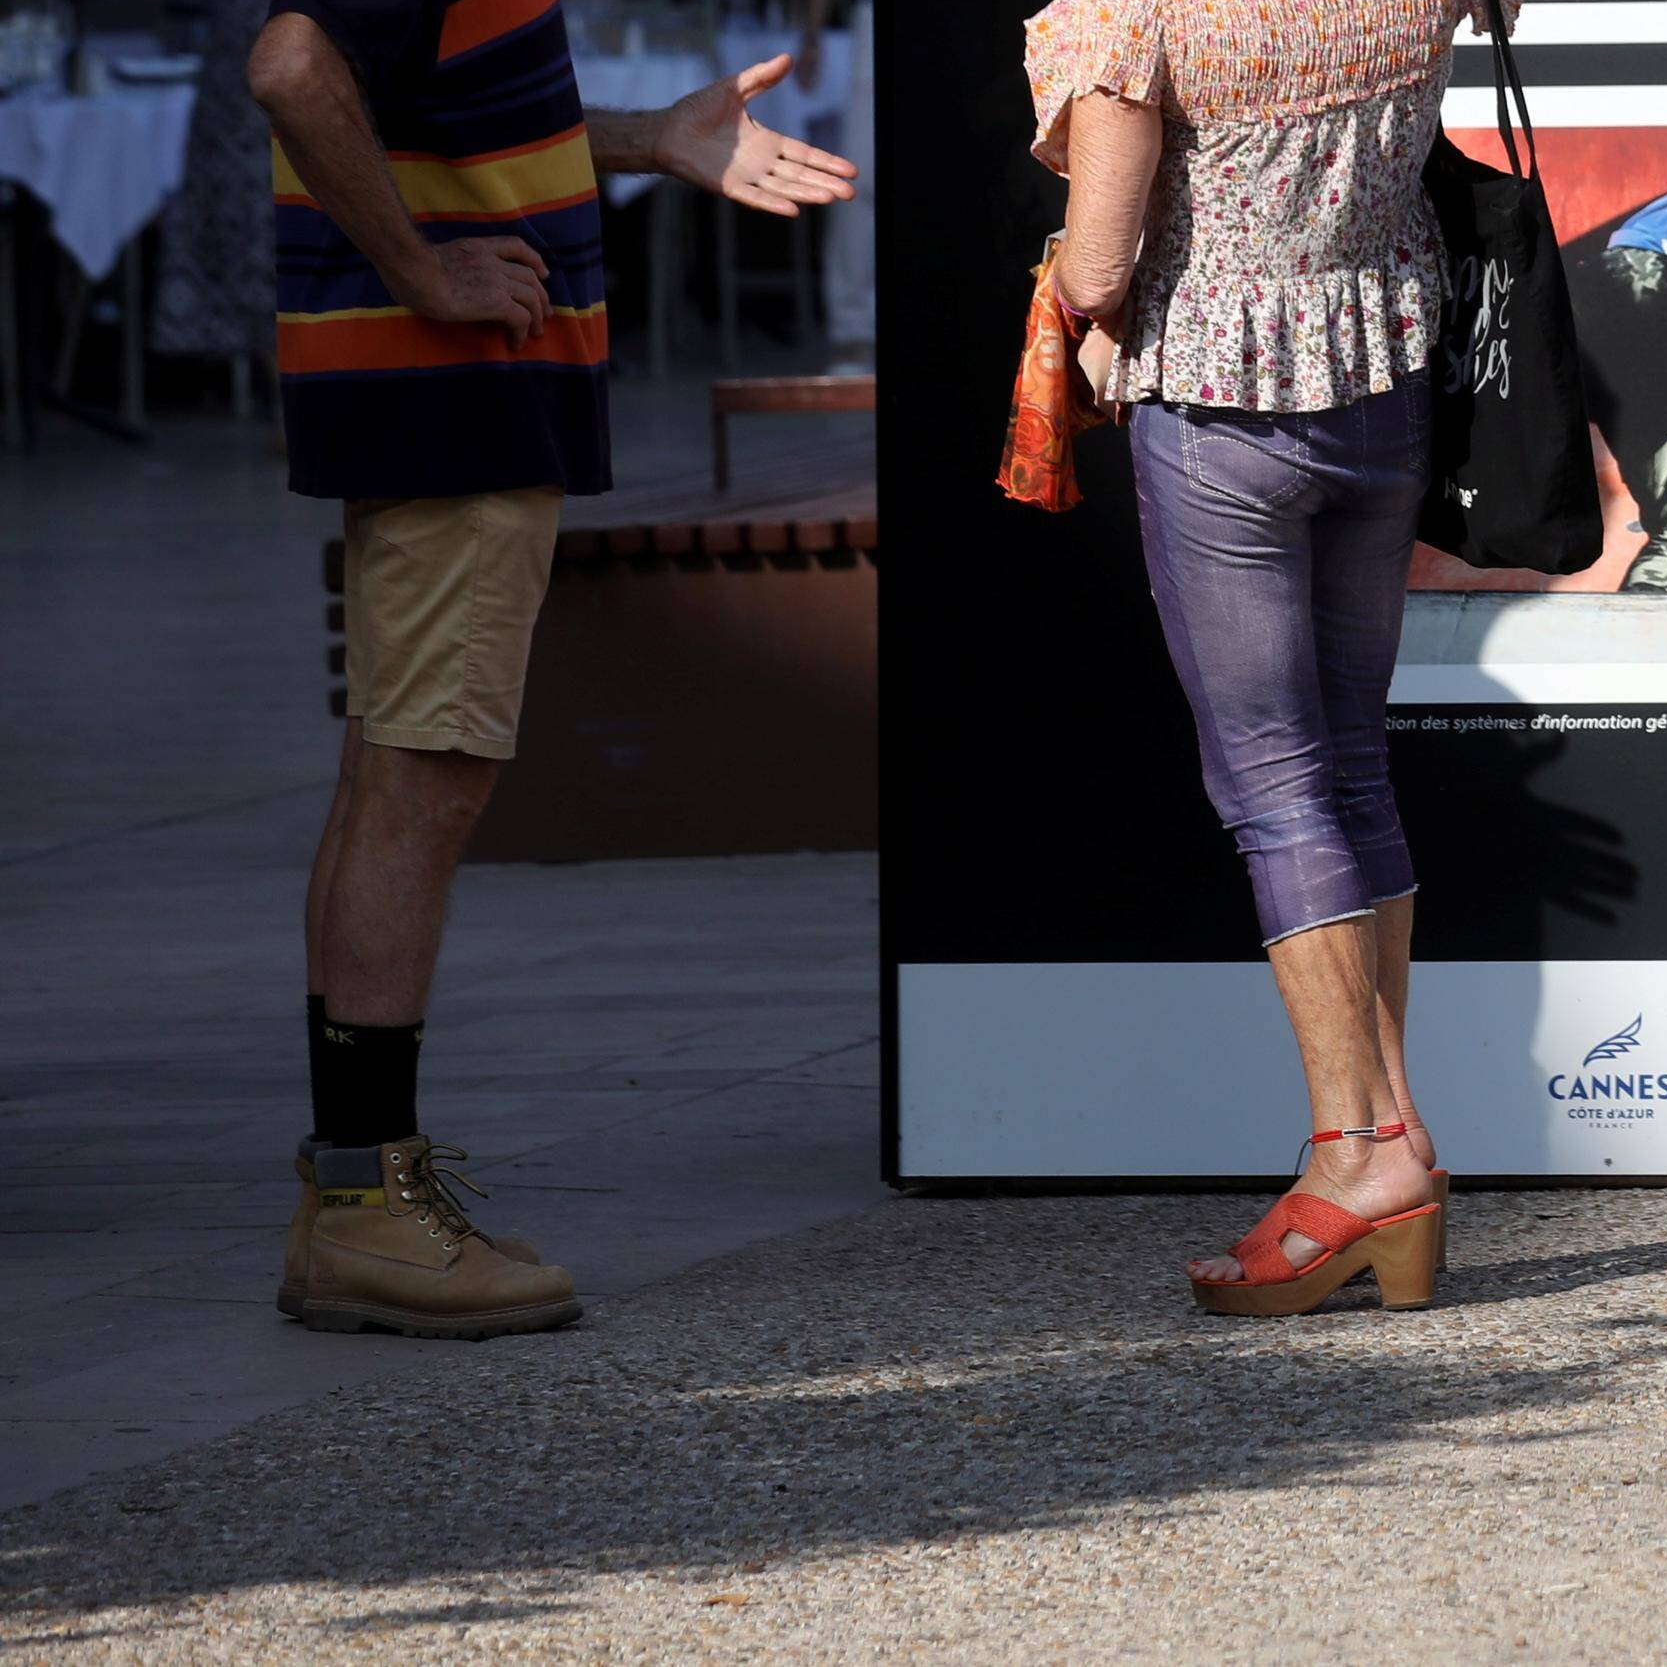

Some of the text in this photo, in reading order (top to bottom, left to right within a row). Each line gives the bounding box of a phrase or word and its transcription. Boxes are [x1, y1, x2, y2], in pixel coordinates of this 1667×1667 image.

[1421, 715, 1451, 730] des
[1453, 714, 1527, 734] systèmes
[1530, 713, 1643, 734] d'information
[1568, 1105, 1655, 1119] CÔTE d'AZUR
